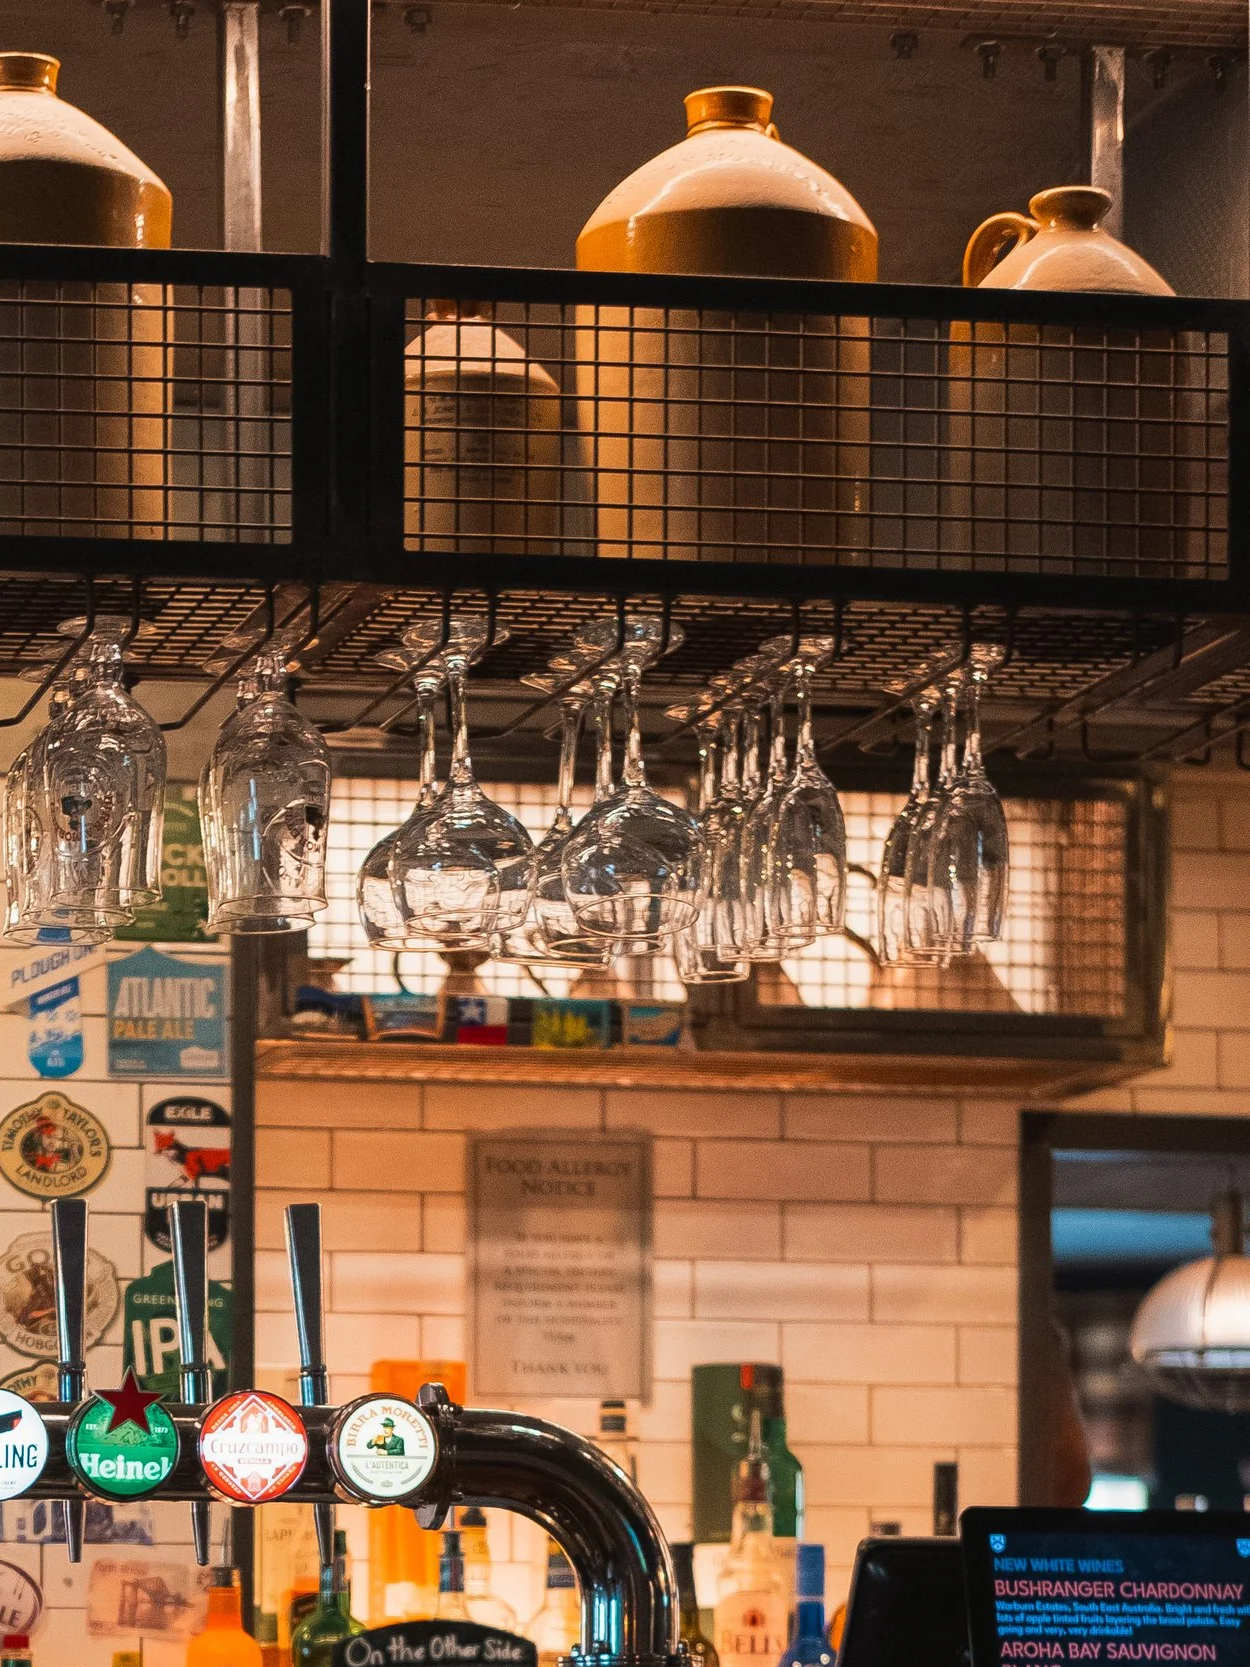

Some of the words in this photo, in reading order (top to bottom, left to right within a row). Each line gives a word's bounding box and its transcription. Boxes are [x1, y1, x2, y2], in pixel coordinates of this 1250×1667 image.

[112, 976, 216, 1019] ATLANTIC
[113, 1020, 154, 1040] PALE
[161, 1021, 195, 1040] ALE
[15, 1163, 87, 1188] LANDLORD
[133, 1292, 176, 1306] GREEN
[347, 1407, 379, 1448] BIRRA
[380, 1405, 429, 1449] MORETTI
[210, 1439, 299, 1457] Cruzcampo
[993, 1557, 1028, 1572] NEW
[1030, 1557, 1075, 1572] WHITE
[1077, 1558, 1125, 1573] WINES
[994, 1579, 1116, 1598] BUSHRANGER
[1119, 1581, 1244, 1600] CHARDONNAY
[1073, 1601, 1099, 1612] South
[1165, 1603, 1192, 1615] Bright
[1194, 1603, 1211, 1615] and
[1014, 1612, 1025, 1623] of
[1026, 1613, 1052, 1625] apple
[1052, 1613, 1080, 1624] tinted
[1143, 1614, 1158, 1625] the
[997, 1625, 1024, 1637] going
[1025, 1625, 1043, 1635] and
[1068, 1626, 1088, 1637] very
[346, 1637, 384, 1667] On
[387, 1635, 425, 1661] the
[430, 1634, 481, 1659] Other
[484, 1637, 522, 1660] Side
[1000, 1641, 1065, 1659] AROHA
[1068, 1642, 1102, 1660] BAY
[1106, 1642, 1218, 1661] SAUVIGNON
